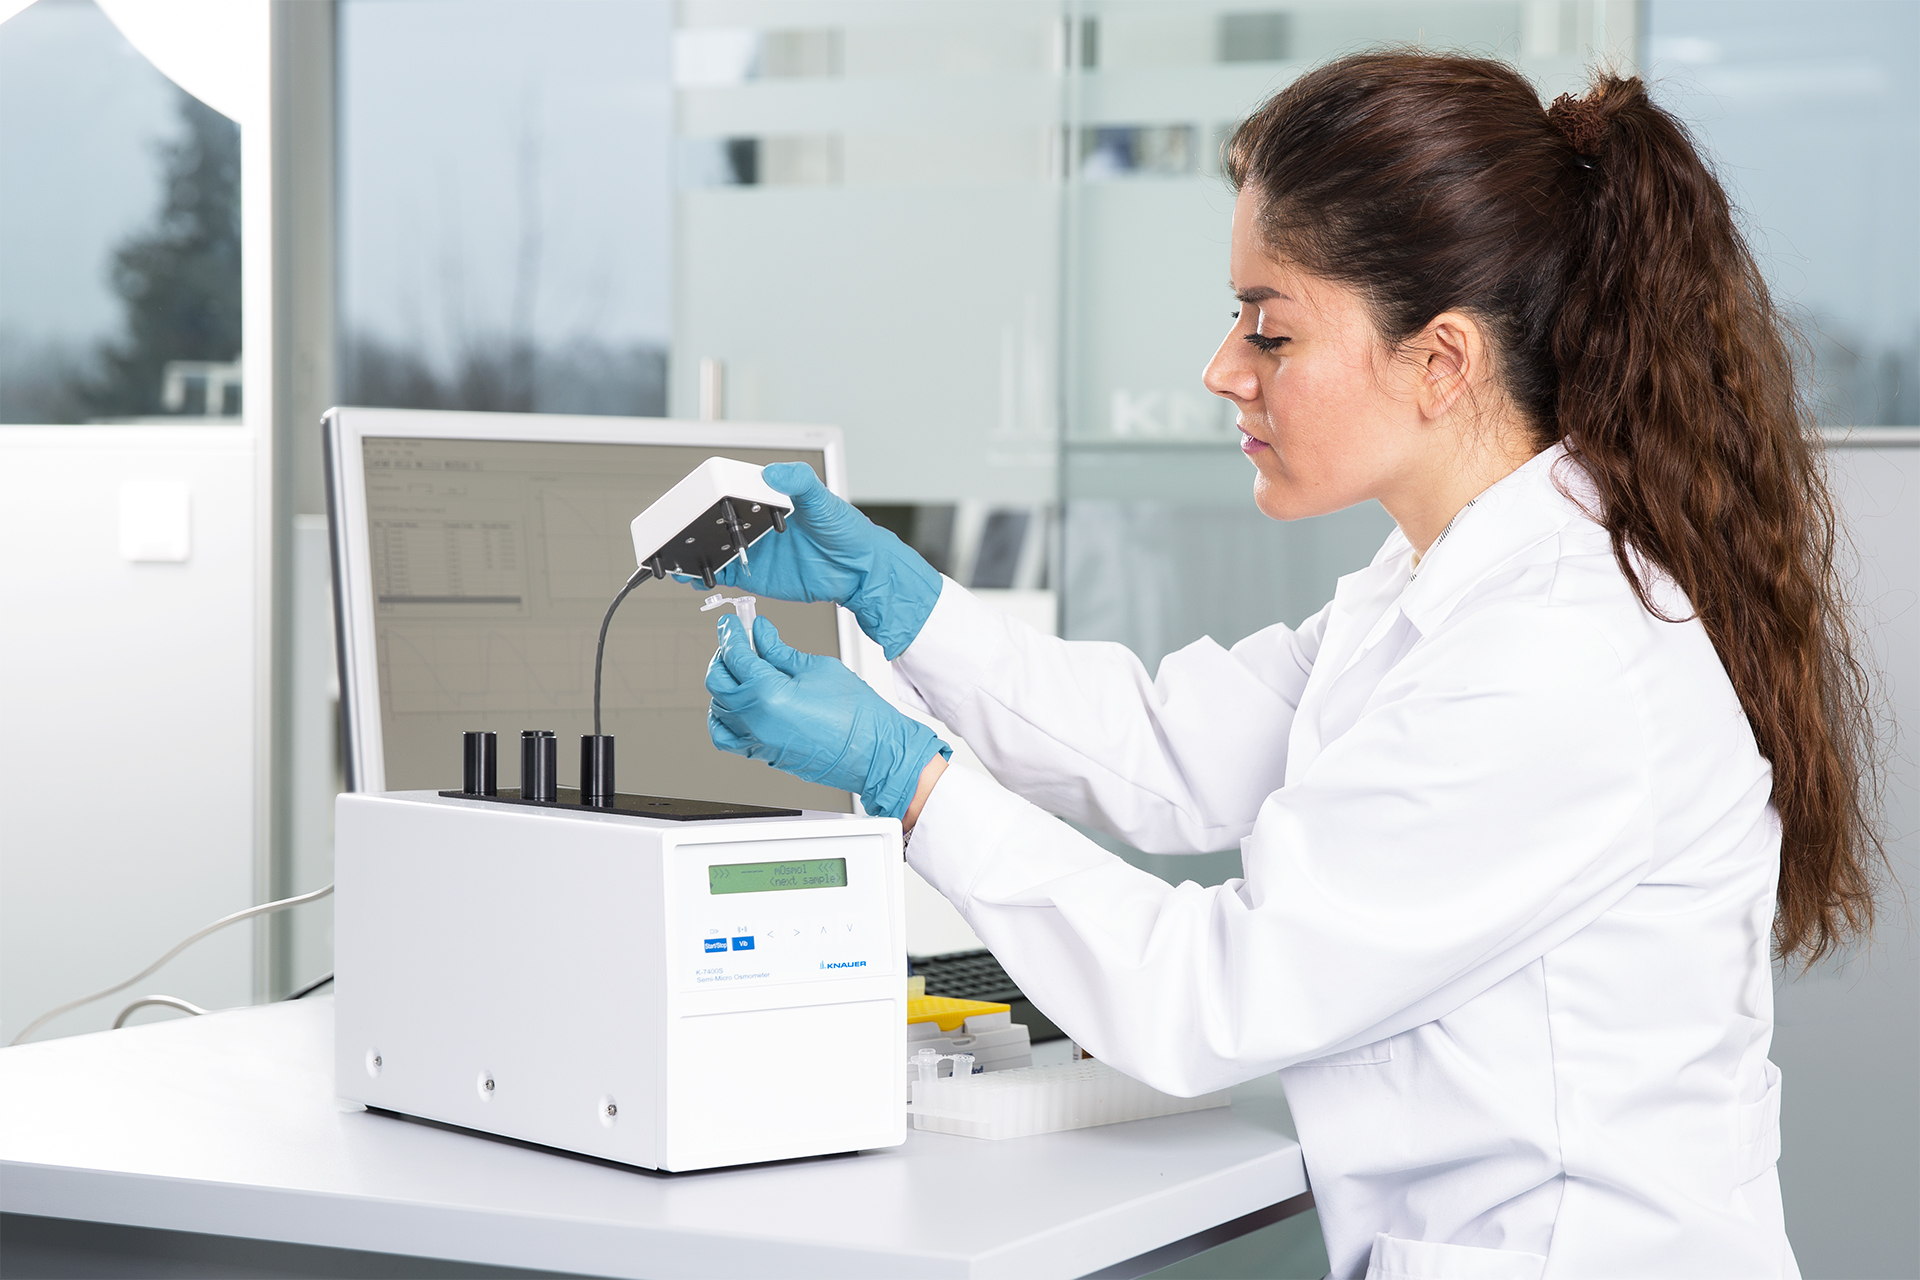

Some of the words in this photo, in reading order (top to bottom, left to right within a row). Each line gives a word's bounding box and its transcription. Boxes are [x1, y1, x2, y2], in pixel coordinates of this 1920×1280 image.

[705, 941, 727, 950] Start/Stop
[827, 961, 866, 970] KNAUER
[695, 967, 723, 976] K-7400S
[696, 975, 732, 984] Semi-Micro
[734, 972, 770, 981] Osmometer
